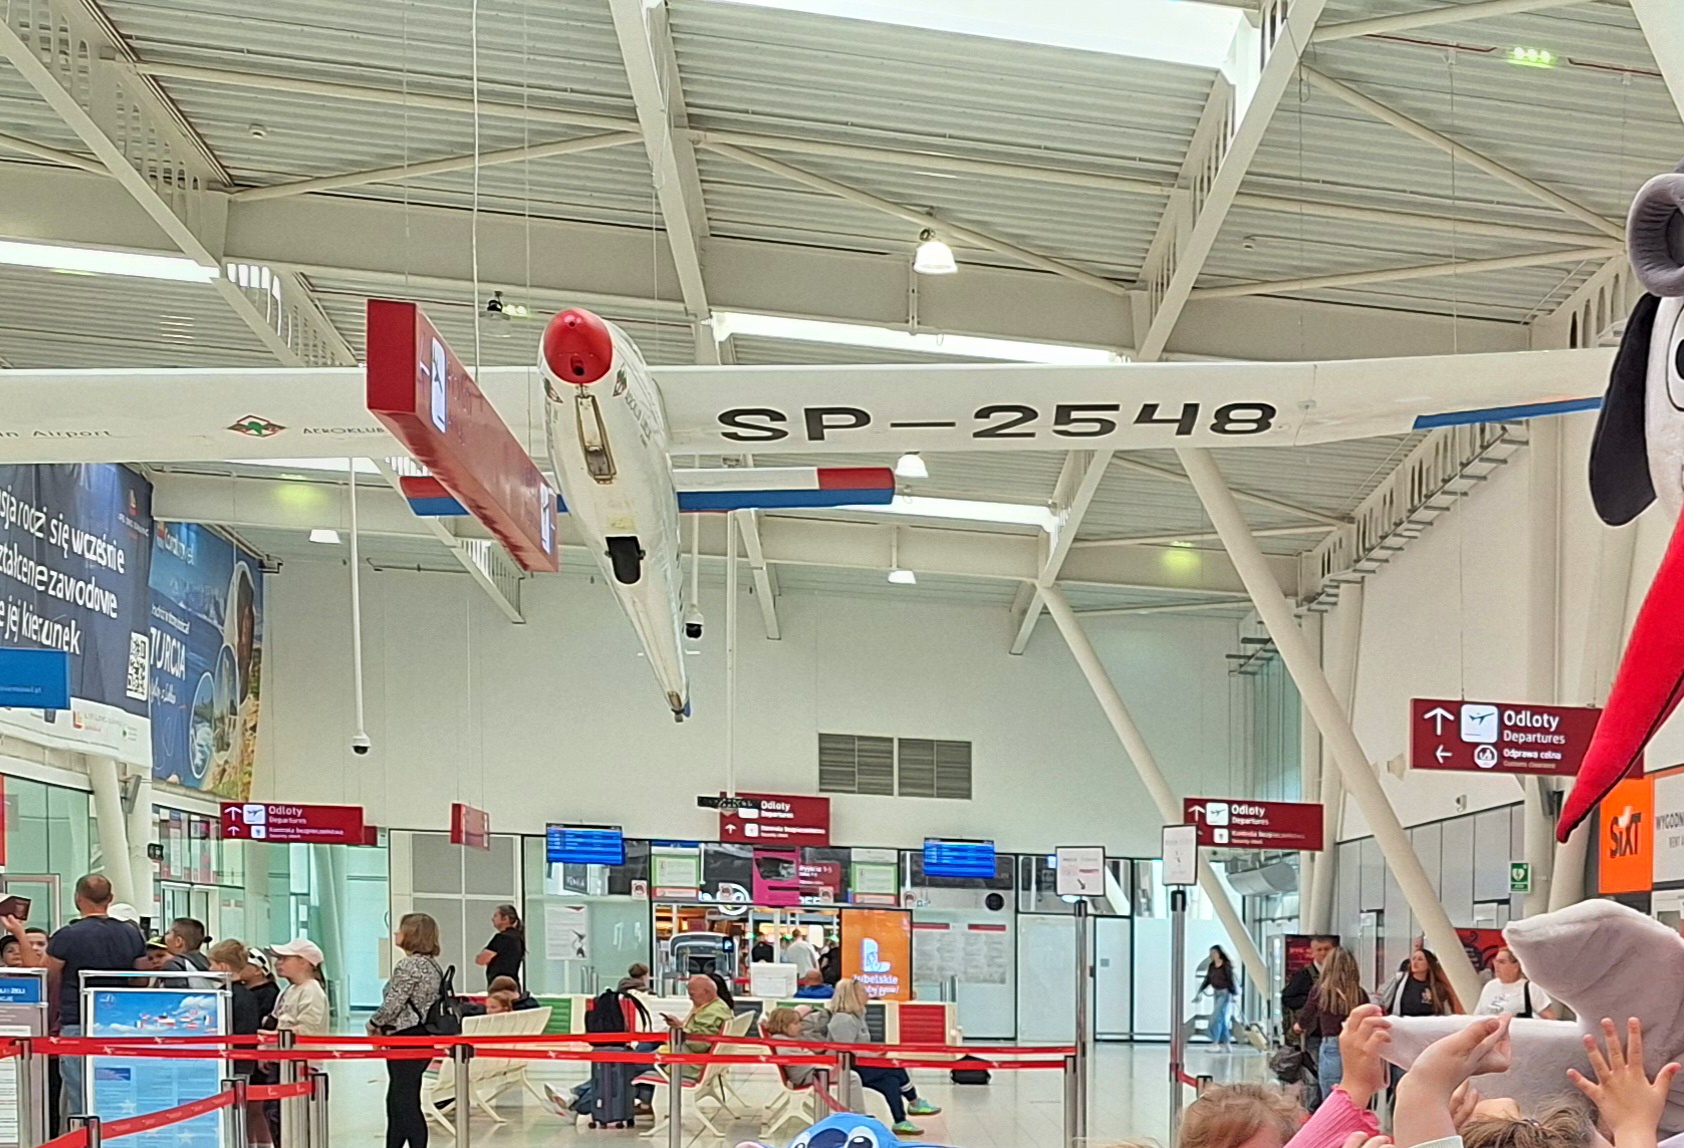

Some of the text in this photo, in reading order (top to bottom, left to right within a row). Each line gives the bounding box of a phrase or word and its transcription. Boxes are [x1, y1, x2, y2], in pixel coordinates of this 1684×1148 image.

[150, 627, 186, 681] TURCJA
[1503, 710, 1559, 732] Odloty
[1503, 730, 1566, 745] Departures
[268, 806, 303, 817] Odloty
[1231, 805, 1266, 817] Odloty
